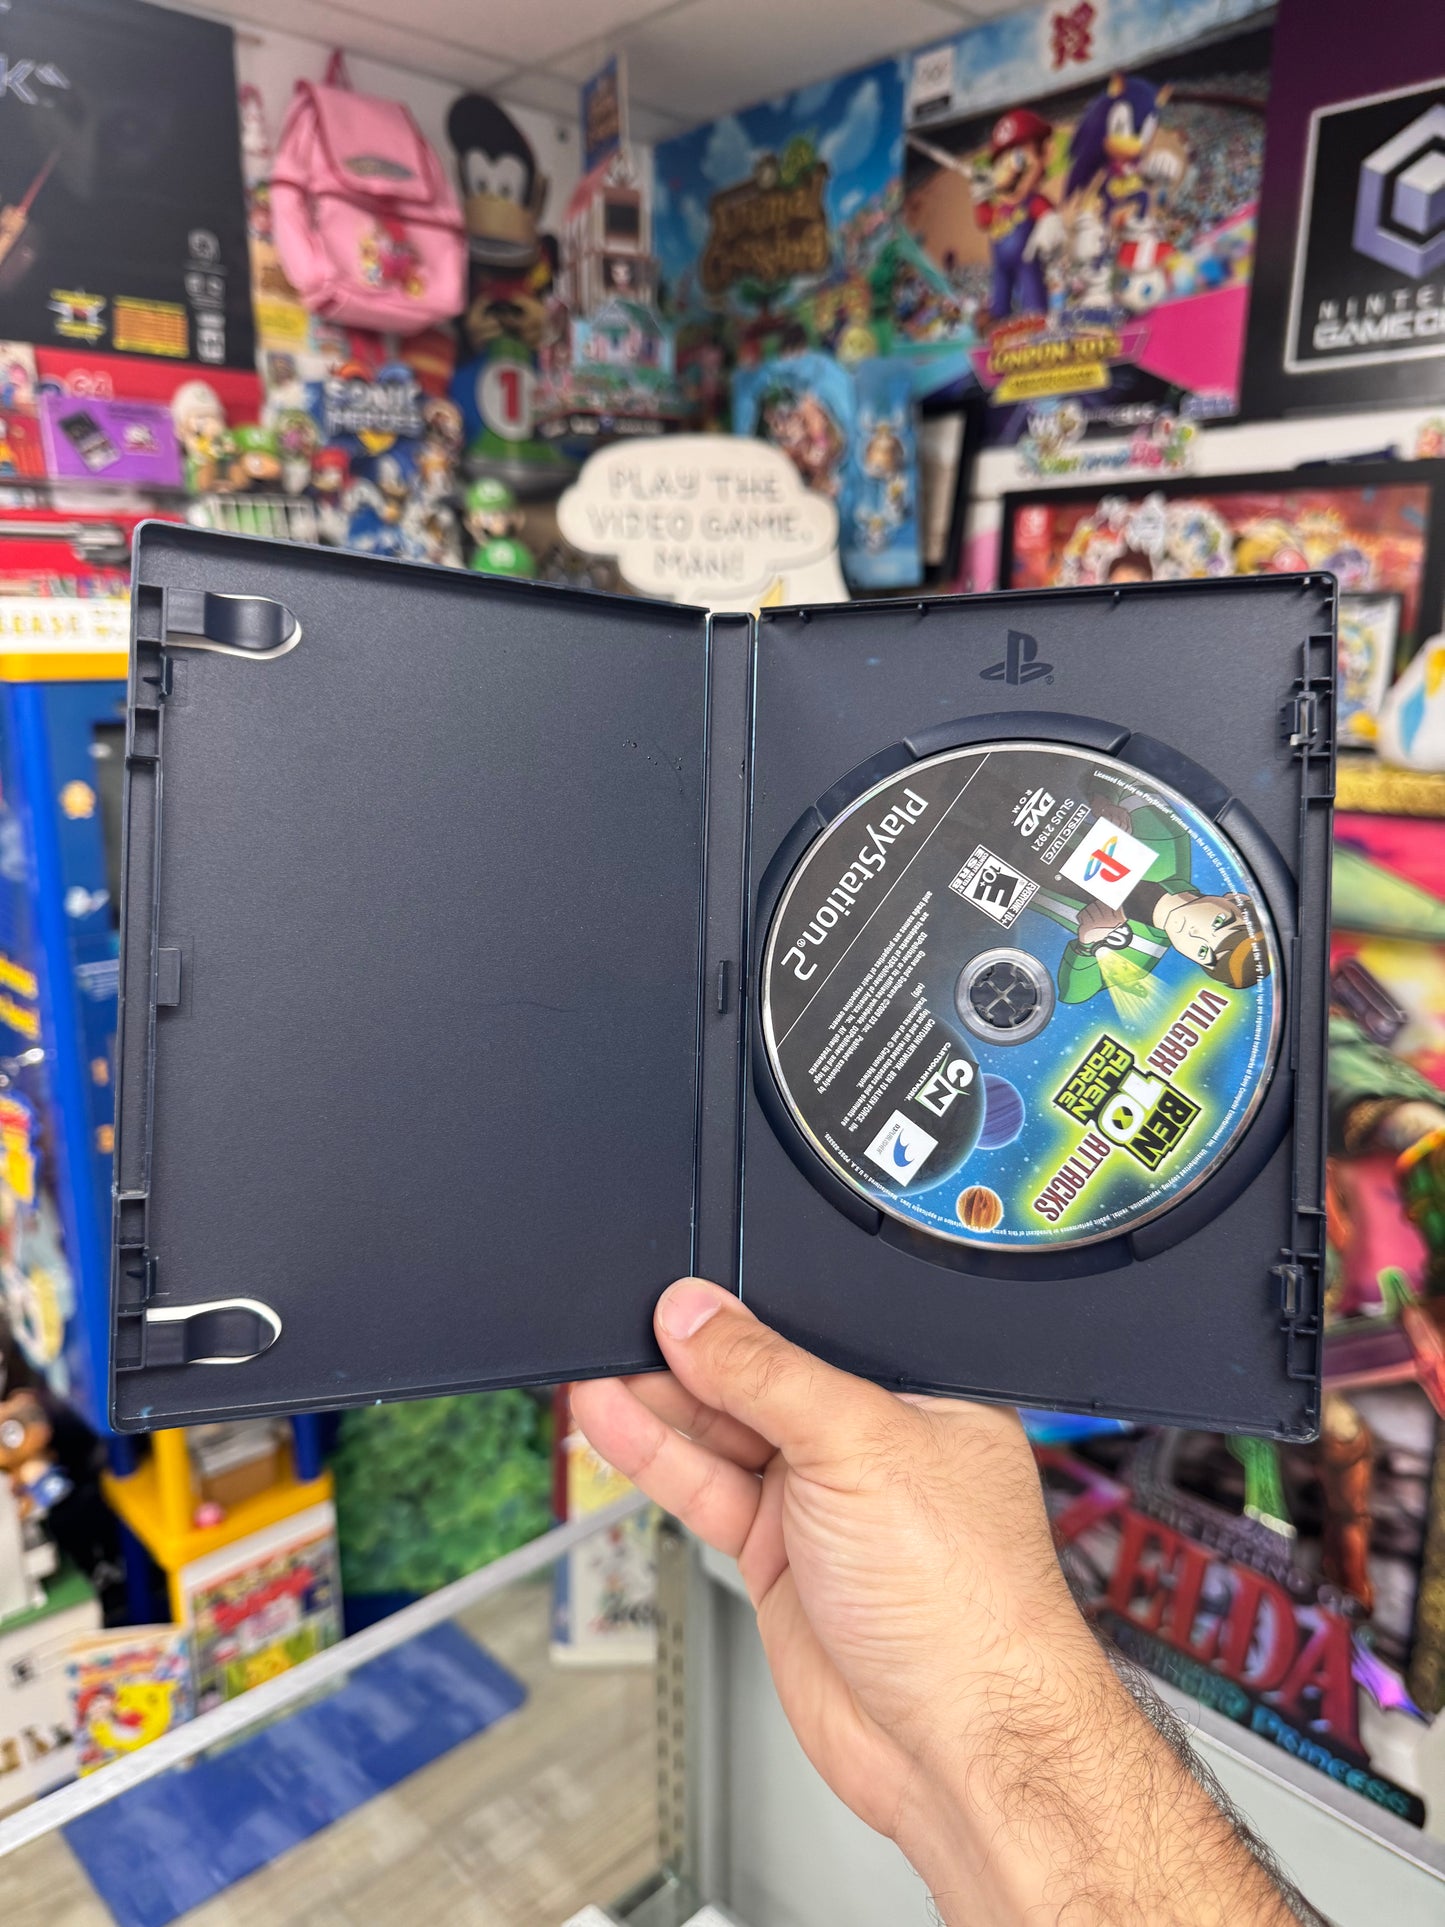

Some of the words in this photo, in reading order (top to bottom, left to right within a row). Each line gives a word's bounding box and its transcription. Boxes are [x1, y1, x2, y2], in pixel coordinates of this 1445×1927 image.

[607, 466, 700, 500] PLAY
[705, 468, 787, 502] THE
[586, 505, 695, 541] VIDEO
[1050, 798, 1074, 824] SLUS
[1062, 809, 1086, 836] NTSC
[1031, 823, 1054, 851] 21921
[1045, 836, 1062, 859] U/C
[951, 847, 984, 889] ESRB
[921, 890, 932, 903] and
[1009, 881, 1036, 913] EVERYONE
[911, 900, 926, 916] trade
[919, 911, 929, 922] are
[1000, 910, 1015, 925] 10+
[899, 914, 915, 933] names
[892, 932, 902, 942] are
[898, 920, 923, 950] trademarks
[873, 940, 896, 968] properties
[893, 948, 901, 957] of
[900, 931, 928, 963] D3Publisher
[910, 949, 926, 967] Game
[860, 972, 874, 987] their
[869, 966, 877, 975] of
[872, 954, 898, 987] D3Publisher
[890, 968, 900, 977] its
[902, 964, 914, 977] and
[841, 984, 864, 1011] respective
[867, 985, 875, 993] of
[874, 975, 894, 999] affiliates
[886, 975, 907, 999] Software
[850, 990, 871, 1014] America,
[854, 997, 878, 1025] worldwide.
[873, 997, 890, 1017] ©2009
[902, 996, 927, 1026] trademarks
[827, 1010, 845, 1030] owners.
[843, 1013, 855, 1024] Inc.
[868, 1015, 878, 1024] D3
[915, 1007, 931, 1024] logos
[837, 1025, 846, 1035] All
[860, 1022, 872, 1033] Inc.
[890, 1030, 901, 1042] and
[897, 1024, 905, 1032] of
[902, 1032, 911, 1042] all
[908, 1022, 919, 1035] and
[912, 1018, 935, 1045] CARTOON
[1147, 989, 1229, 1076] VILGAX
[827, 1033, 840, 1048] other
[833, 1024, 859, 1056] D3Publisher
[841, 1034, 864, 1061] Published
[889, 1039, 906, 1060] related
[807, 1046, 831, 1075] trademarks
[826, 1054, 836, 1066] and
[871, 1046, 890, 1067] Cartoon
[926, 1041, 951, 1072] CARTOON
[812, 1070, 825, 1084] logo
[821, 1064, 830, 1073] its
[821, 1058, 845, 1087] exclusively
[855, 1065, 876, 1088] Network.
[870, 1058, 893, 1085] characters
[884, 1070, 897, 1083] BEN
[1058, 1040, 1112, 1111] FORCE
[816, 1085, 826, 1094] by
[863, 1083, 874, 1096] and
[879, 1081, 888, 1090] 10
[1071, 1049, 1131, 1121] ALIEN
[846, 1093, 866, 1118] elements
[868, 1087, 883, 1105] ALIEN
[853, 1102, 872, 1123] FORCE,
[1100, 1071, 1167, 1145] 10
[840, 1115, 849, 1126] are
[847, 1121, 858, 1132] the
[1134, 1090, 1192, 1166] BEN
[874, 1122, 901, 1155] D3PUBLISHER
[1032, 1132, 1111, 1223] ATTACKS
